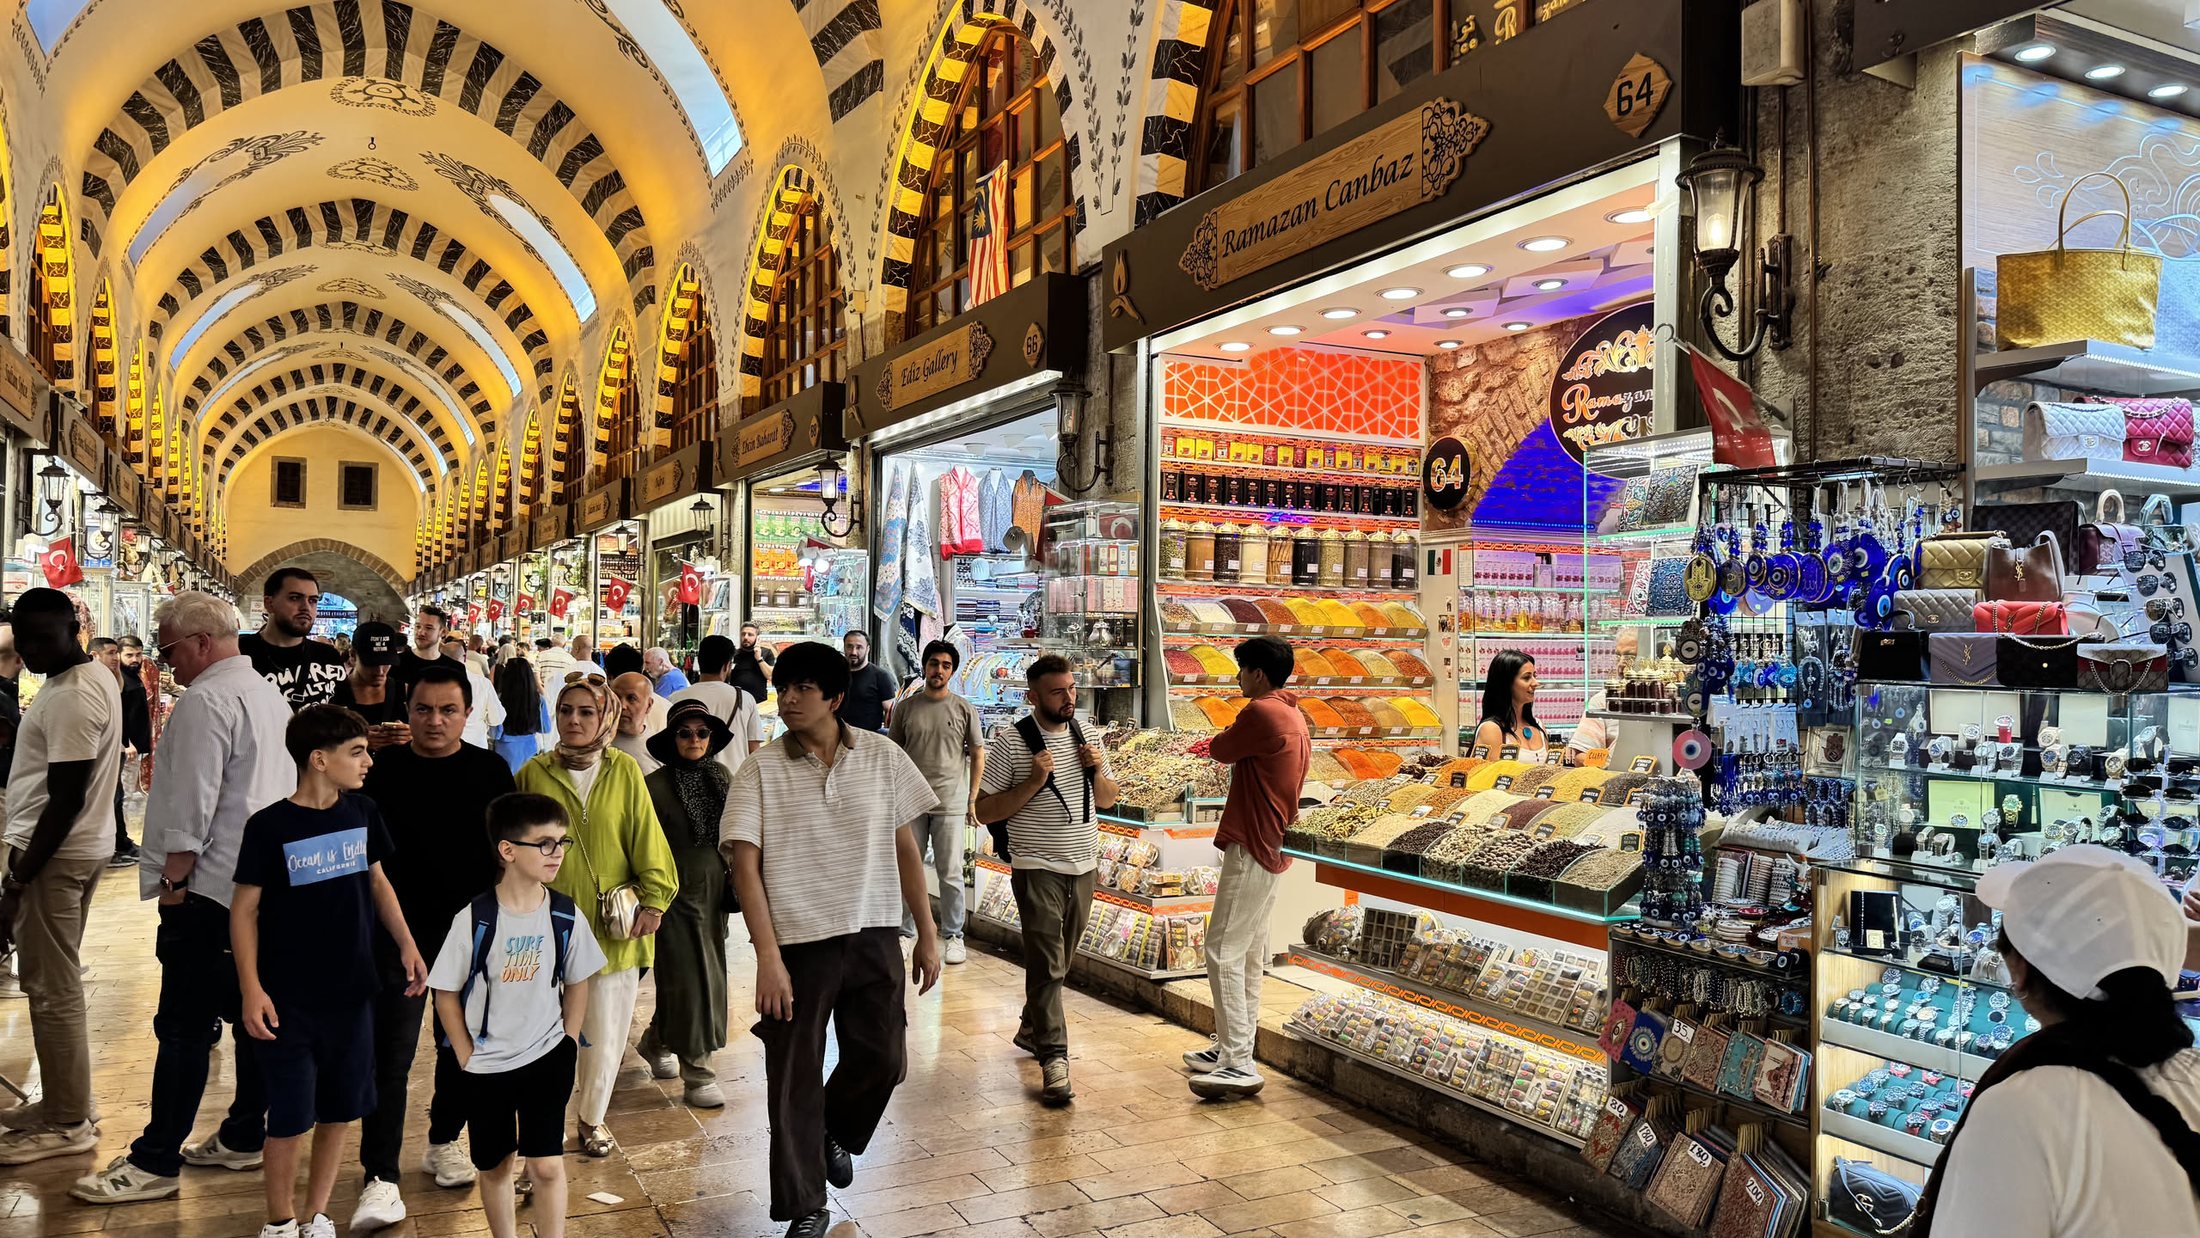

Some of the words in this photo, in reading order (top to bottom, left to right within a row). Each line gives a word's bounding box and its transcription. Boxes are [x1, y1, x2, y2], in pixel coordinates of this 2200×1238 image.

[1617, 71, 1654, 116] 64
[1221, 196, 1319, 258] Ramazan
[1325, 151, 1414, 212] Canbaz
[1026, 334, 1038, 356] 66
[901, 361, 921, 387] Ediz
[922, 348, 958, 382] Gallery
[1430, 454, 1464, 492] 64
[288, 852, 323, 873] Ocean
[506, 935, 544, 954] SURF
[504, 950, 542, 968] TIME
[502, 966, 540, 983] ONLY
[109, 1175, 132, 1191] N
